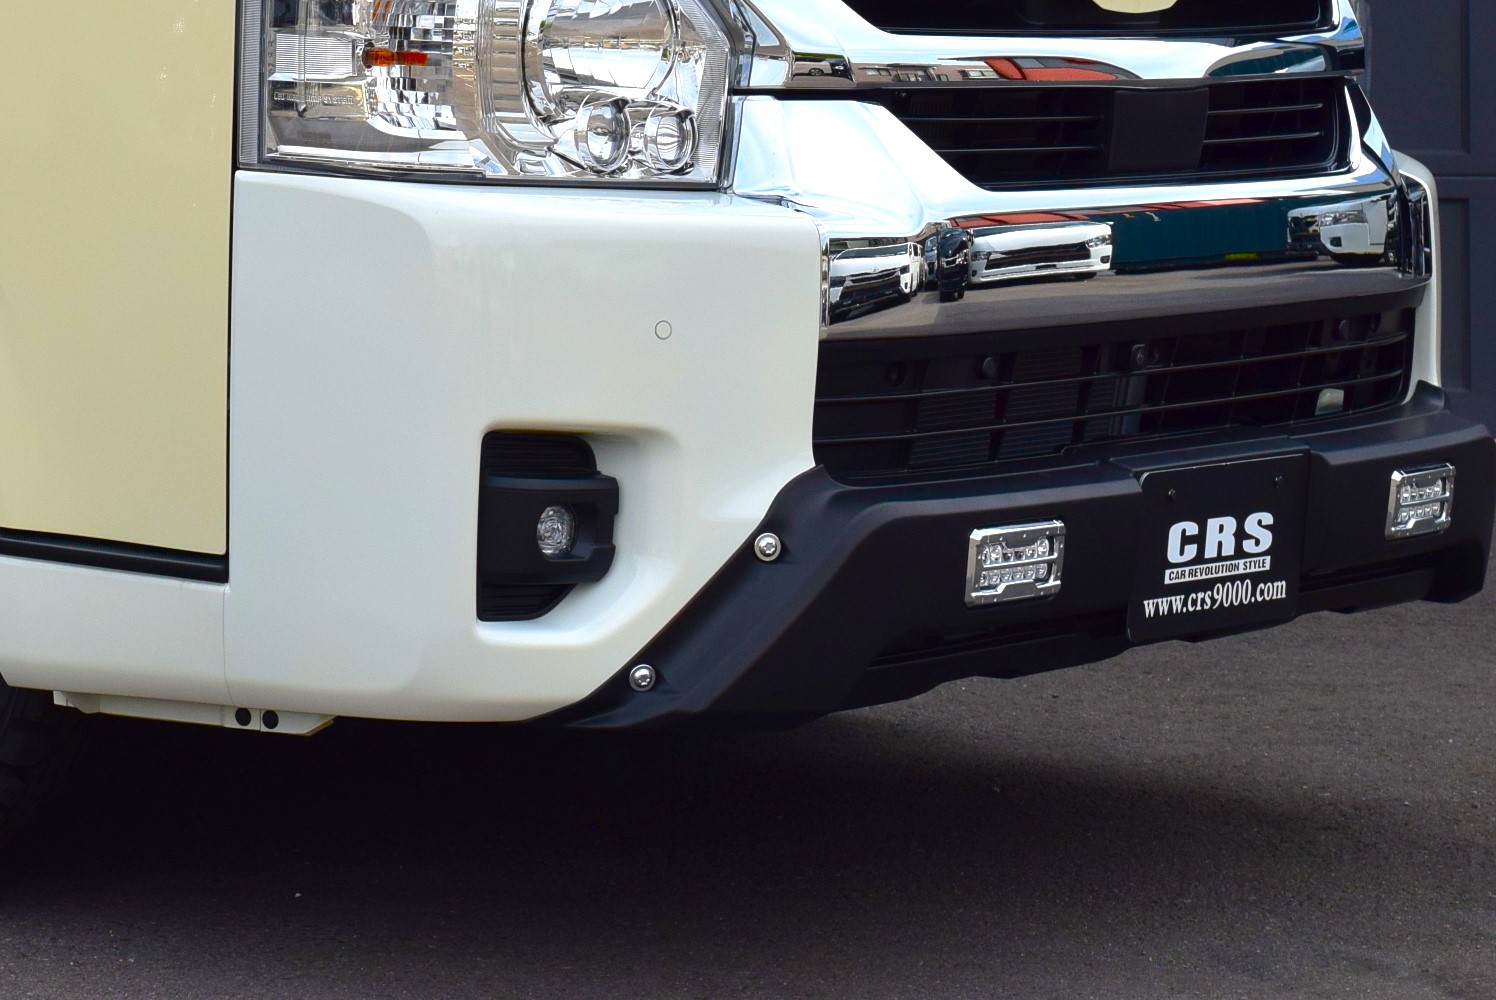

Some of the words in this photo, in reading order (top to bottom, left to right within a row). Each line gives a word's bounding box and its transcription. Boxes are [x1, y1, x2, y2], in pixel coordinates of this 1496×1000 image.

[1166, 511, 1274, 564] CRS
[1168, 567, 1187, 582] CAR
[1187, 561, 1240, 579] REVOLUTION
[1242, 558, 1267, 571] STYLE
[1143, 578, 1287, 618] www.crs9000.com
